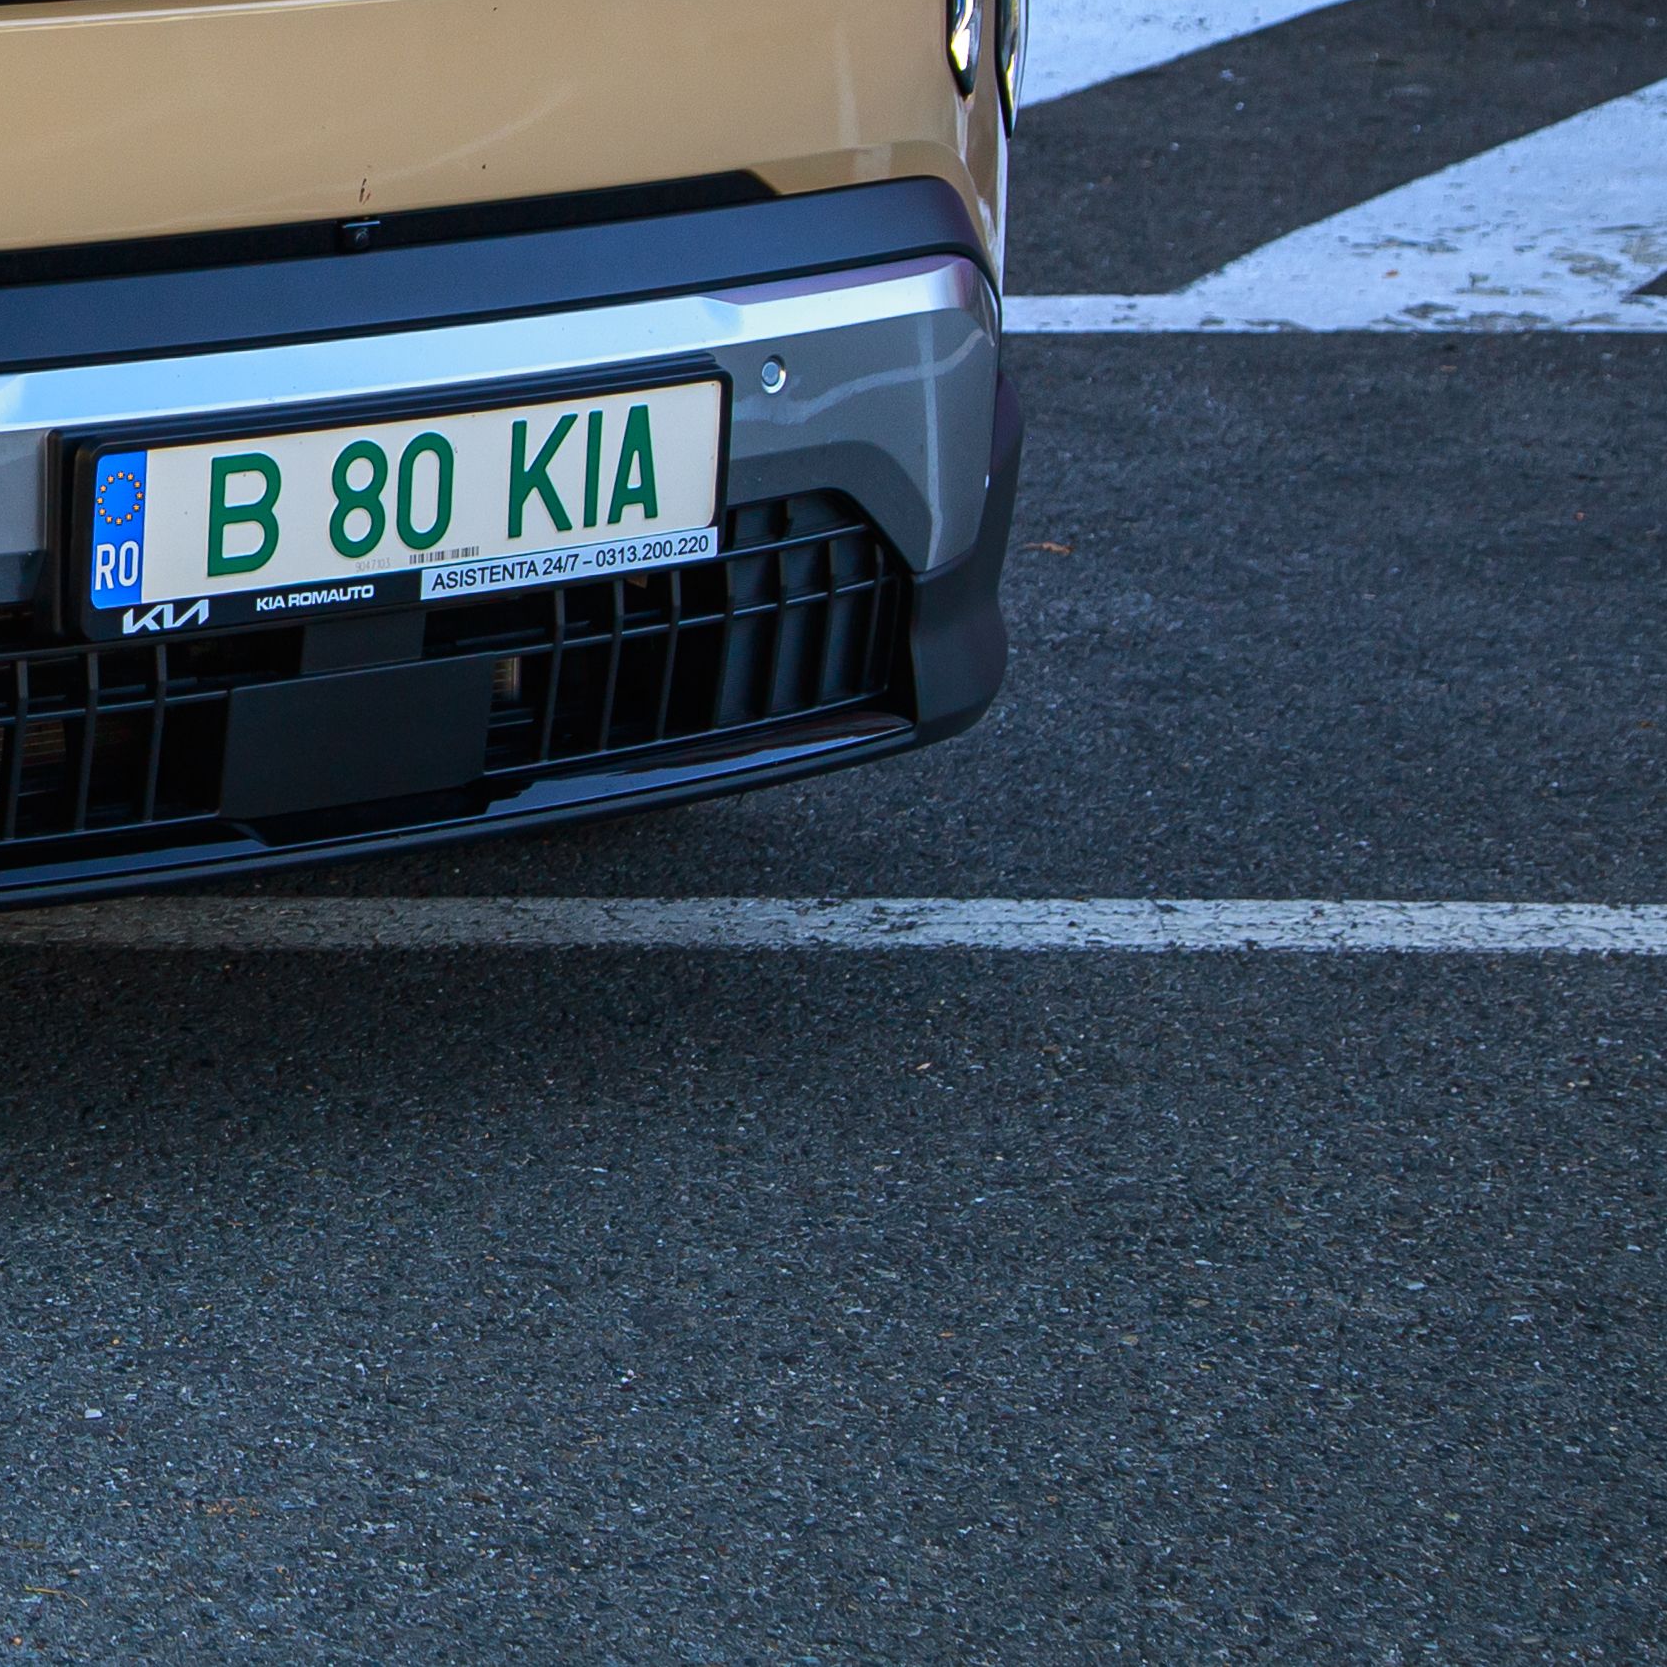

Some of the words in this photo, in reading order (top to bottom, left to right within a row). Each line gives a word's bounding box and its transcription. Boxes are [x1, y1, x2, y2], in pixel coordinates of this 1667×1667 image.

[206, 451, 282, 578] B
[329, 431, 455, 560] 80
[507, 403, 659, 539] KIA
[95, 540, 139, 591] RO
[431, 560, 539, 591] ASISTENTA
[542, 553, 580, 576] 24/7
[595, 535, 709, 569] 0313.200.220
[122, 599, 210, 635] KIA
[256, 596, 286, 612] KIA
[288, 584, 374, 608] ROMAUTO
